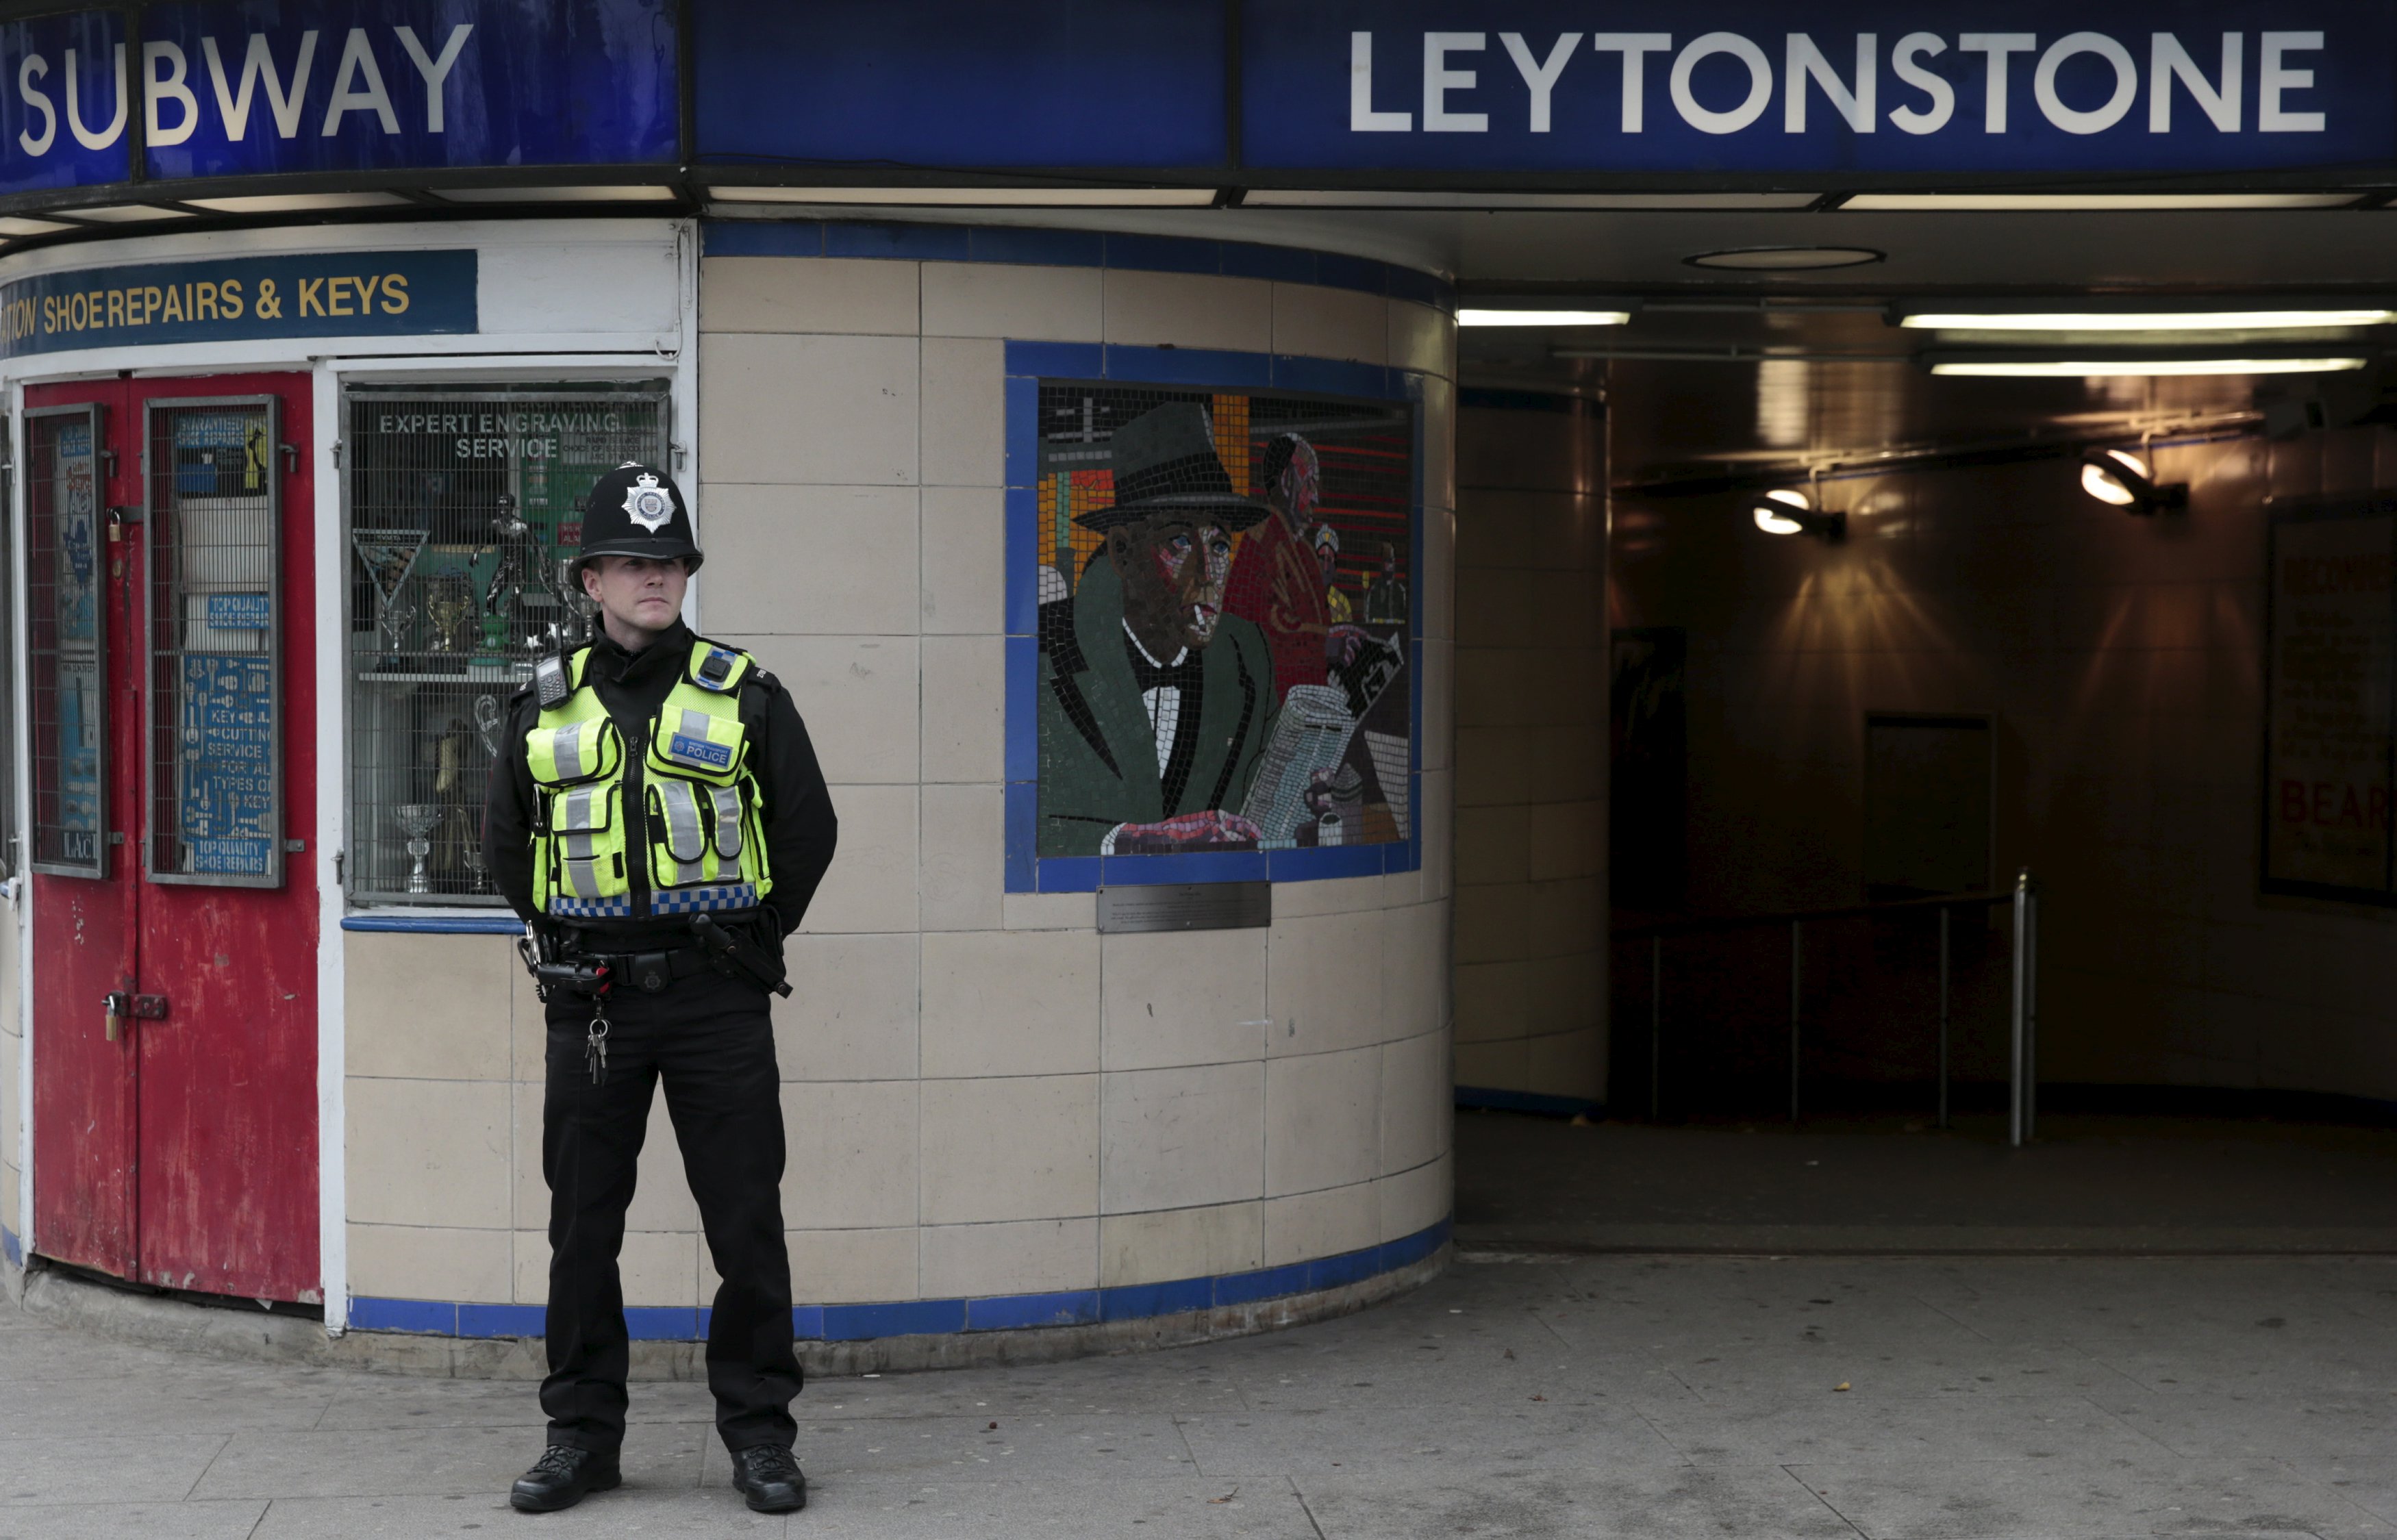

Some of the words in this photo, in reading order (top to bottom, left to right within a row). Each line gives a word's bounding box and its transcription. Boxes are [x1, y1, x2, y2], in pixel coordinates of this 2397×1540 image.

[19, 24, 474, 157] SUBWAY
[1351, 31, 2326, 135] LEYTONSTONE
[255, 279, 283, 318] &
[299, 274, 410, 317] KEYS
[380, 414, 473, 433] EXPERT
[480, 412, 620, 433] ENGRAVING
[456, 438, 557, 458] SERVICE
[232, 597, 269, 613] QUALIT
[212, 709, 236, 724] KEY
[208, 742, 262, 759] SERVICE
[687, 746, 727, 764] POLICE
[213, 776, 254, 792] TYPES
[199, 840, 217, 855] TOP
